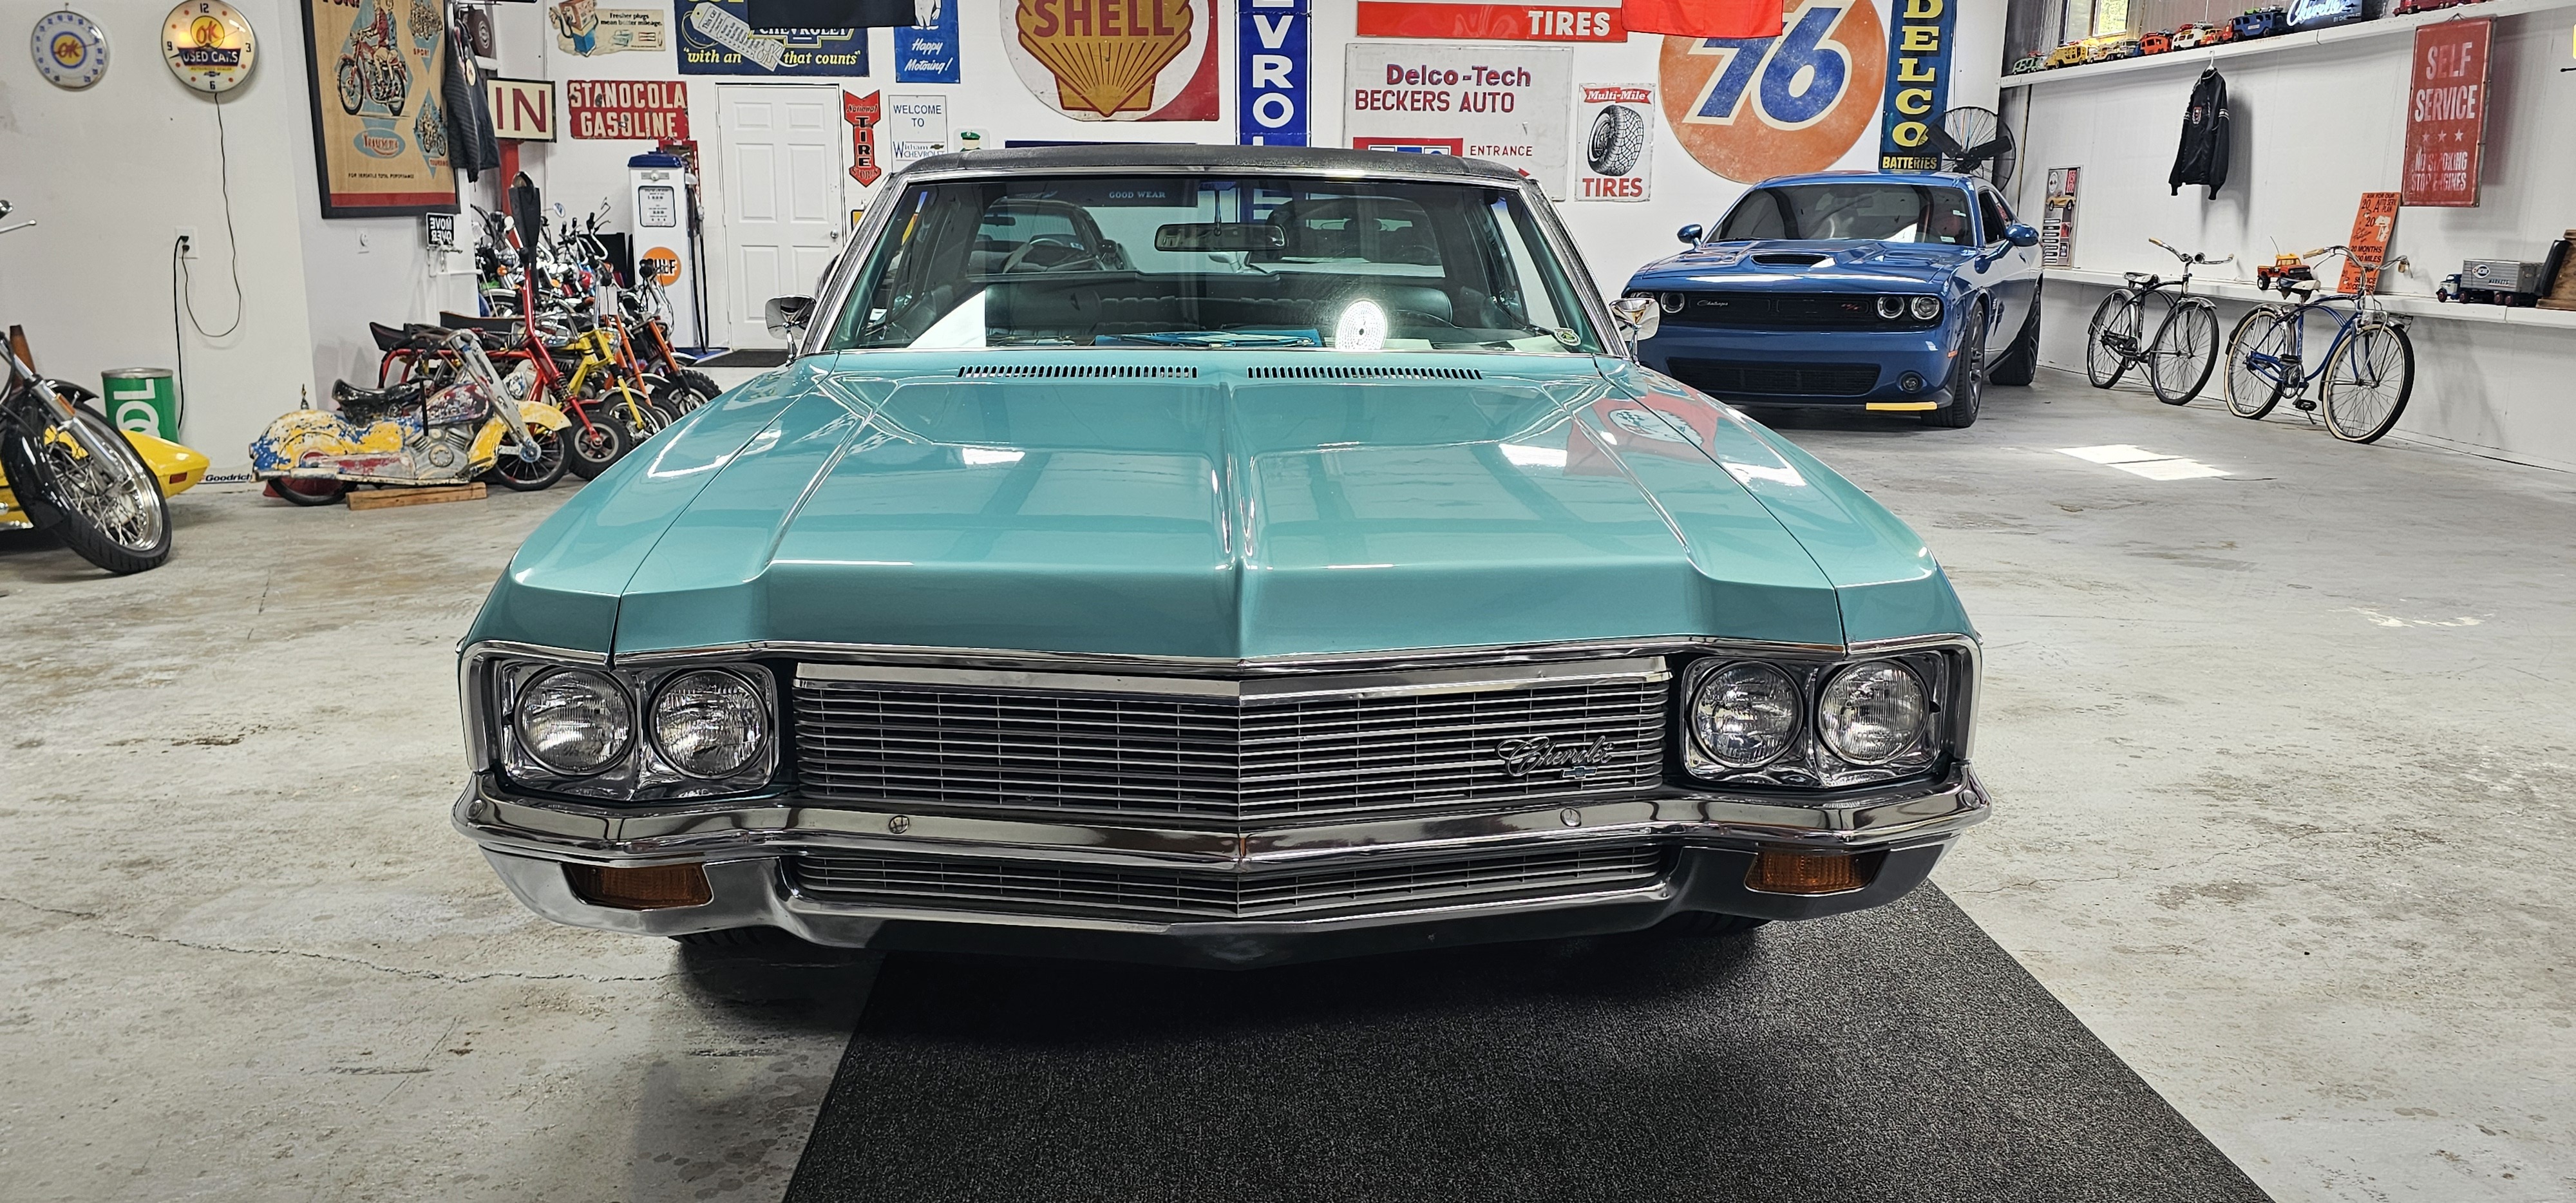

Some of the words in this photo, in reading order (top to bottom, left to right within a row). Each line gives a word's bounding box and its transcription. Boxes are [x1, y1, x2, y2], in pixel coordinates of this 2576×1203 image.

[200, 3, 209, 13] 12
[1033, 0, 1174, 37] SHELL
[1528, 10, 1610, 36] TIRES
[196, 21, 219, 44] OK
[59, 40, 80, 58] OK
[167, 41, 173, 51] 9
[245, 43, 251, 52] 3
[912, 38, 943, 55] Happy
[183, 51, 208, 62] USED
[723, 53, 741, 63] an
[784, 52, 812, 64] that
[2426, 42, 2472, 80] SELF
[904, 57, 953, 74] Motoring!
[1682, 0, 1852, 131] 76
[1892, 0, 1944, 147] DELCO
[210, 81, 216, 90] 6
[569, 82, 686, 108] STANOCOLA
[1355, 89, 1450, 111] BECKERS
[1459, 91, 1515, 113] AUTO
[1587, 90, 1646, 100] Multi-Mile
[2415, 85, 2477, 122] SERVICE
[496, 87, 546, 133] IN
[893, 104, 942, 115] WELCOME
[580, 111, 677, 137] GASOLINE
[911, 118, 925, 128] TO
[856, 117, 870, 167] TIRE
[1470, 146, 1533, 156] ENTRANCE
[1882, 156, 1937, 170] BATTERIES
[1582, 177, 1643, 197] TIRES
[2365, 216, 2376, 227] 20
[2358, 245, 2382, 254] MONTHS
[1495, 735, 1615, 777] Chevrolet
